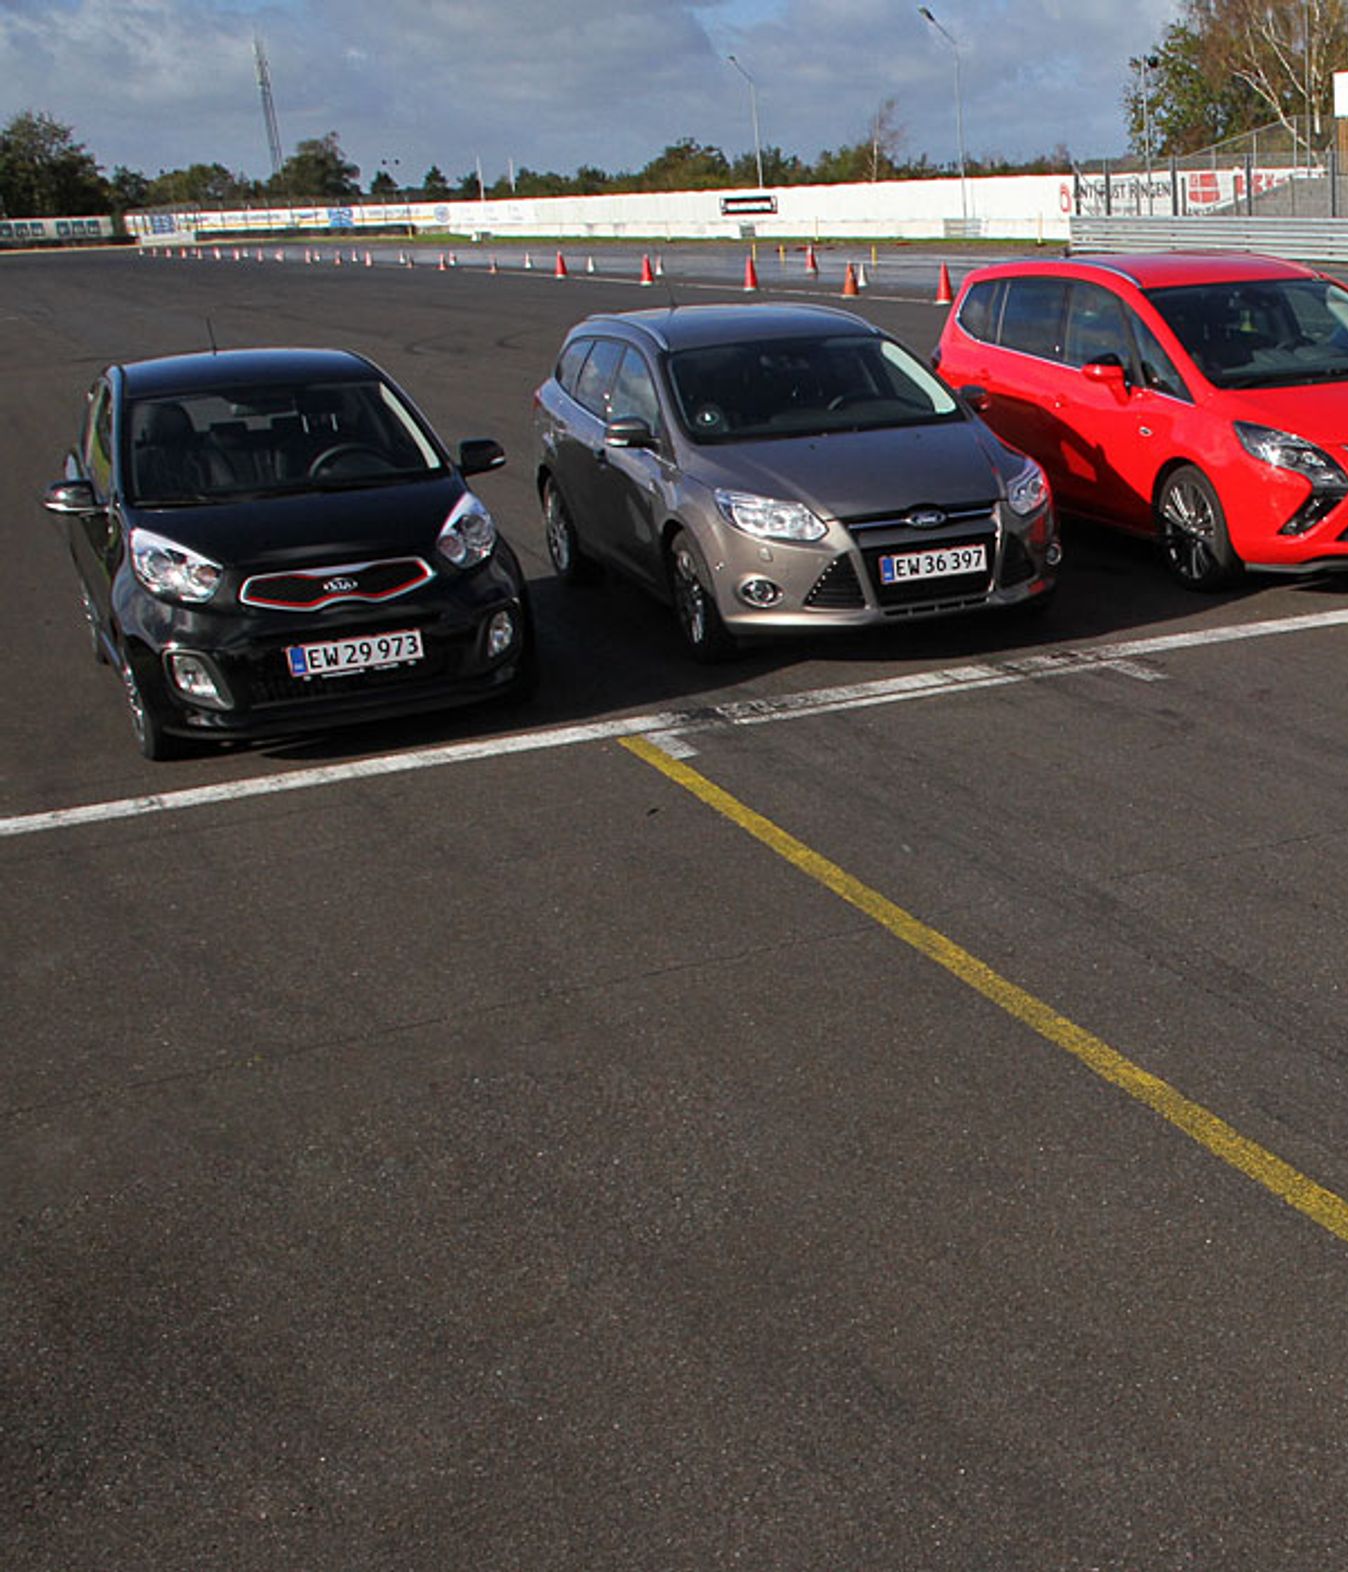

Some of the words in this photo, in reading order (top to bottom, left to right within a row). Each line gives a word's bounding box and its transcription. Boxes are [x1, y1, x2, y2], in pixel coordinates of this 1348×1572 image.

[1129, 181, 1171, 198] RNGEN
[896, 558, 920, 576] EW
[925, 554, 946, 573] 36
[951, 550, 982, 569] 397
[308, 648, 338, 668] EW
[344, 642, 371, 663] 29
[377, 635, 418, 659] 973
